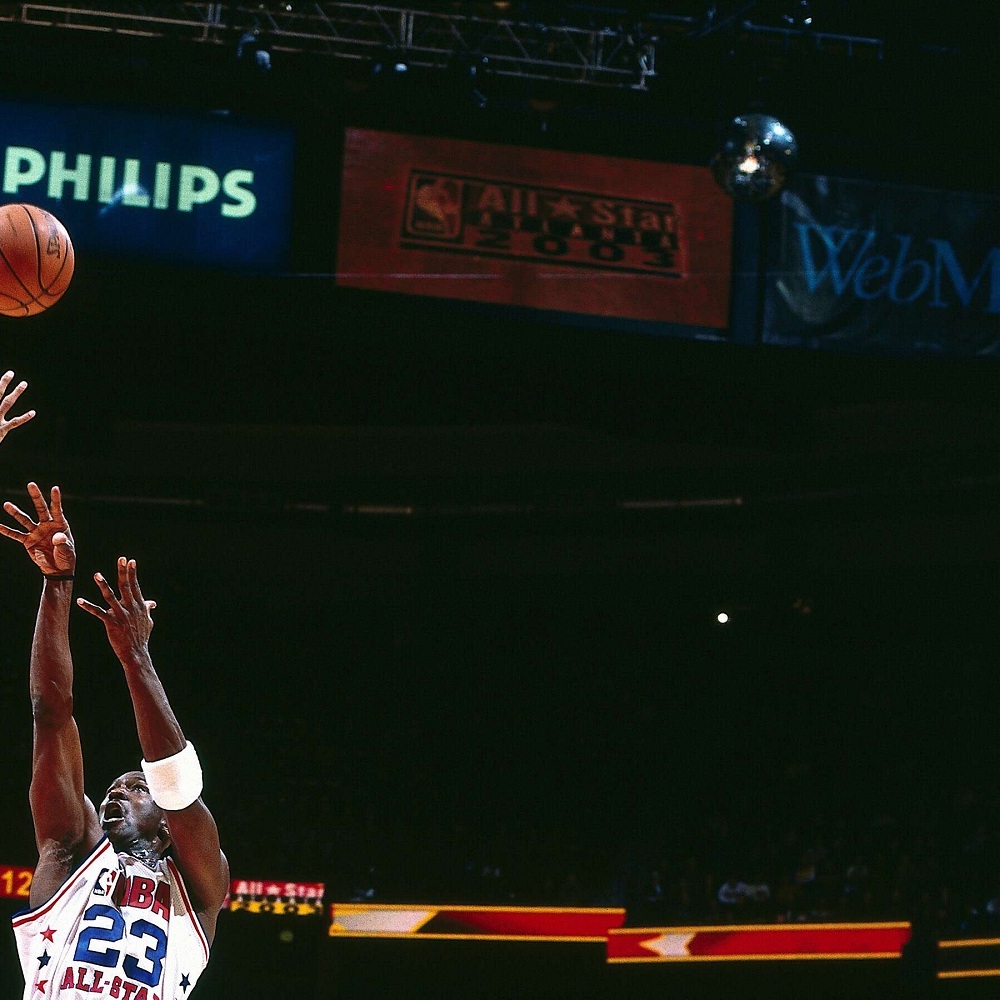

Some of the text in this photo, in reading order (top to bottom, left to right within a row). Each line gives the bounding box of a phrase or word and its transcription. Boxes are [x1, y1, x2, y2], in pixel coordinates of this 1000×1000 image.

[2, 146, 258, 219] PHILIPS
[478, 184, 538, 217] All
[475, 228, 676, 268] 2003
[72, 903, 169, 988] 23
